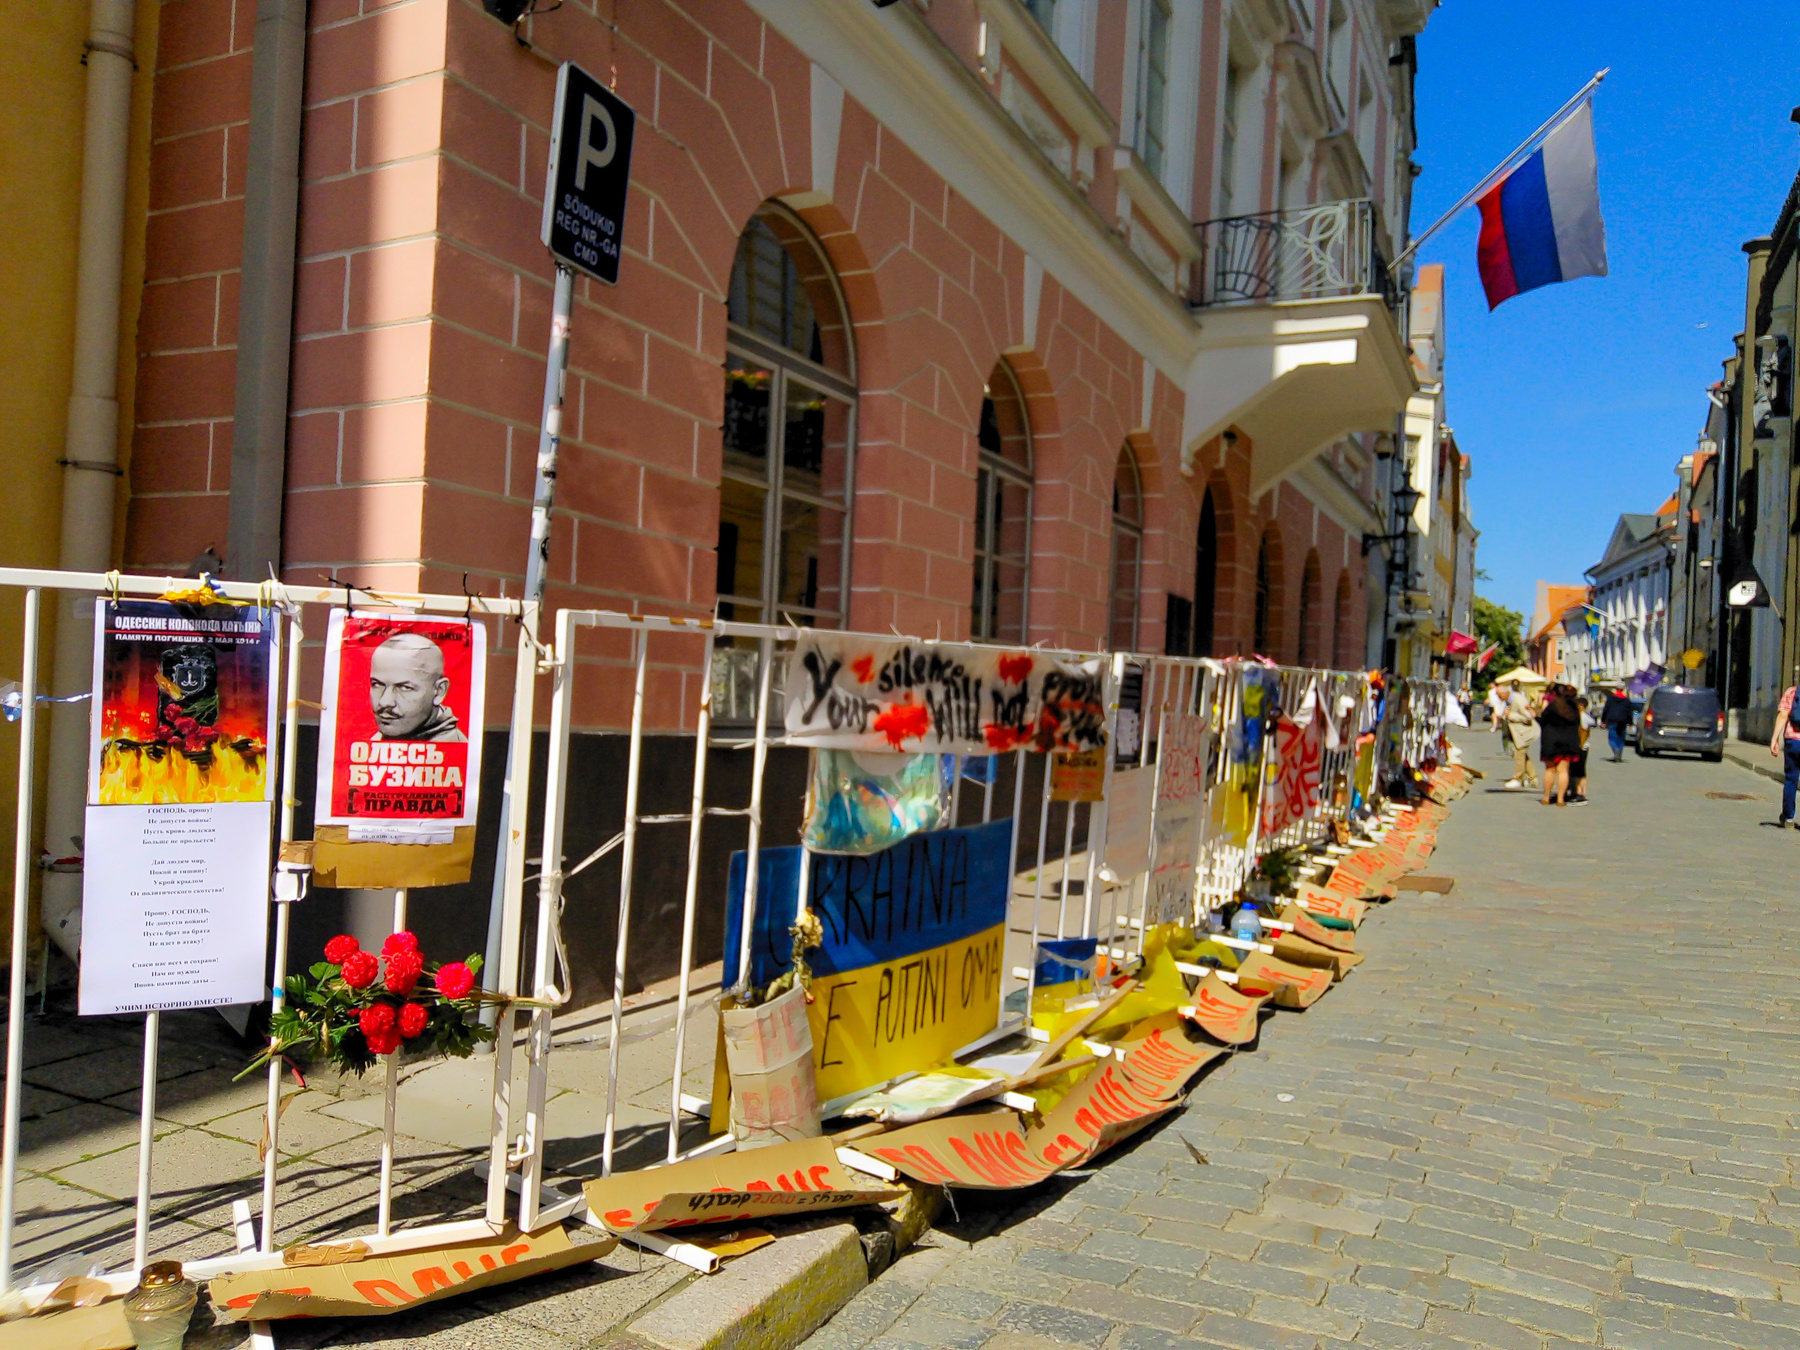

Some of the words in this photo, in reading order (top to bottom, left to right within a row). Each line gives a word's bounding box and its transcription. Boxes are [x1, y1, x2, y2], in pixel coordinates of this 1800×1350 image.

[574, 92, 617, 191] P
[556, 209, 580, 235] REG
[574, 241, 598, 266] CMD
[115, 615, 167, 631] ОДЕССКИЕ
[115, 634, 152, 642] ПАМЯТИ
[154, 635, 204, 643] ПОГИБШИХ
[801, 650, 881, 734] Your
[350, 741, 444, 765] ОЛЕСЬ
[348, 764, 463, 787] БУЗИНА
[364, 799, 446, 815] ПРАВДА
[115, 1004, 143, 1012] УЧИМ
[144, 999, 192, 1010] ИСТОРИЮ
[193, 996, 233, 1006] ВМЕСТЕ!
